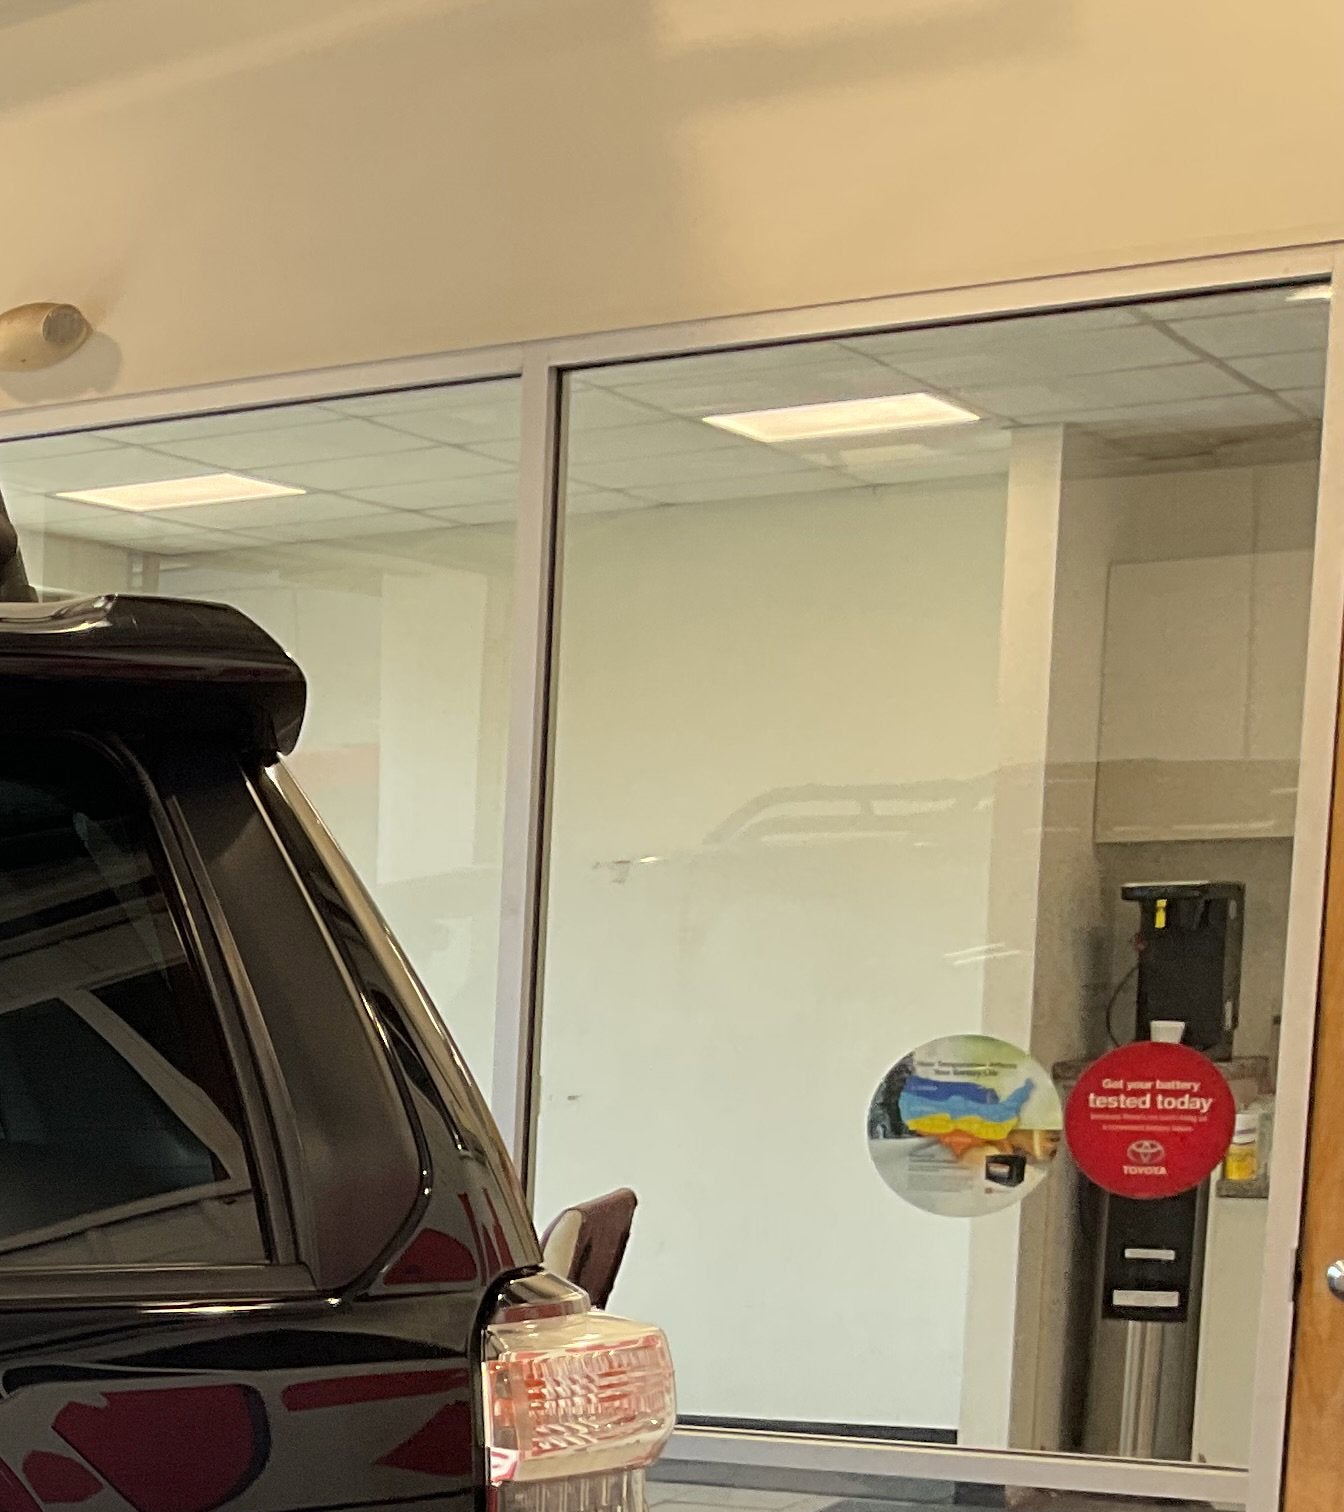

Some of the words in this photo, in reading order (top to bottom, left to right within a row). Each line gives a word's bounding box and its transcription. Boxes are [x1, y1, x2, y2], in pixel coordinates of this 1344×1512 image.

[1101, 1078, 1124, 1089] Get
[1126, 1080, 1154, 1091] your
[1156, 1079, 1201, 1092] battery
[1088, 1092, 1152, 1109] tested
[1156, 1093, 1213, 1113] today
[1122, 1164, 1168, 1175] TOYOTA
